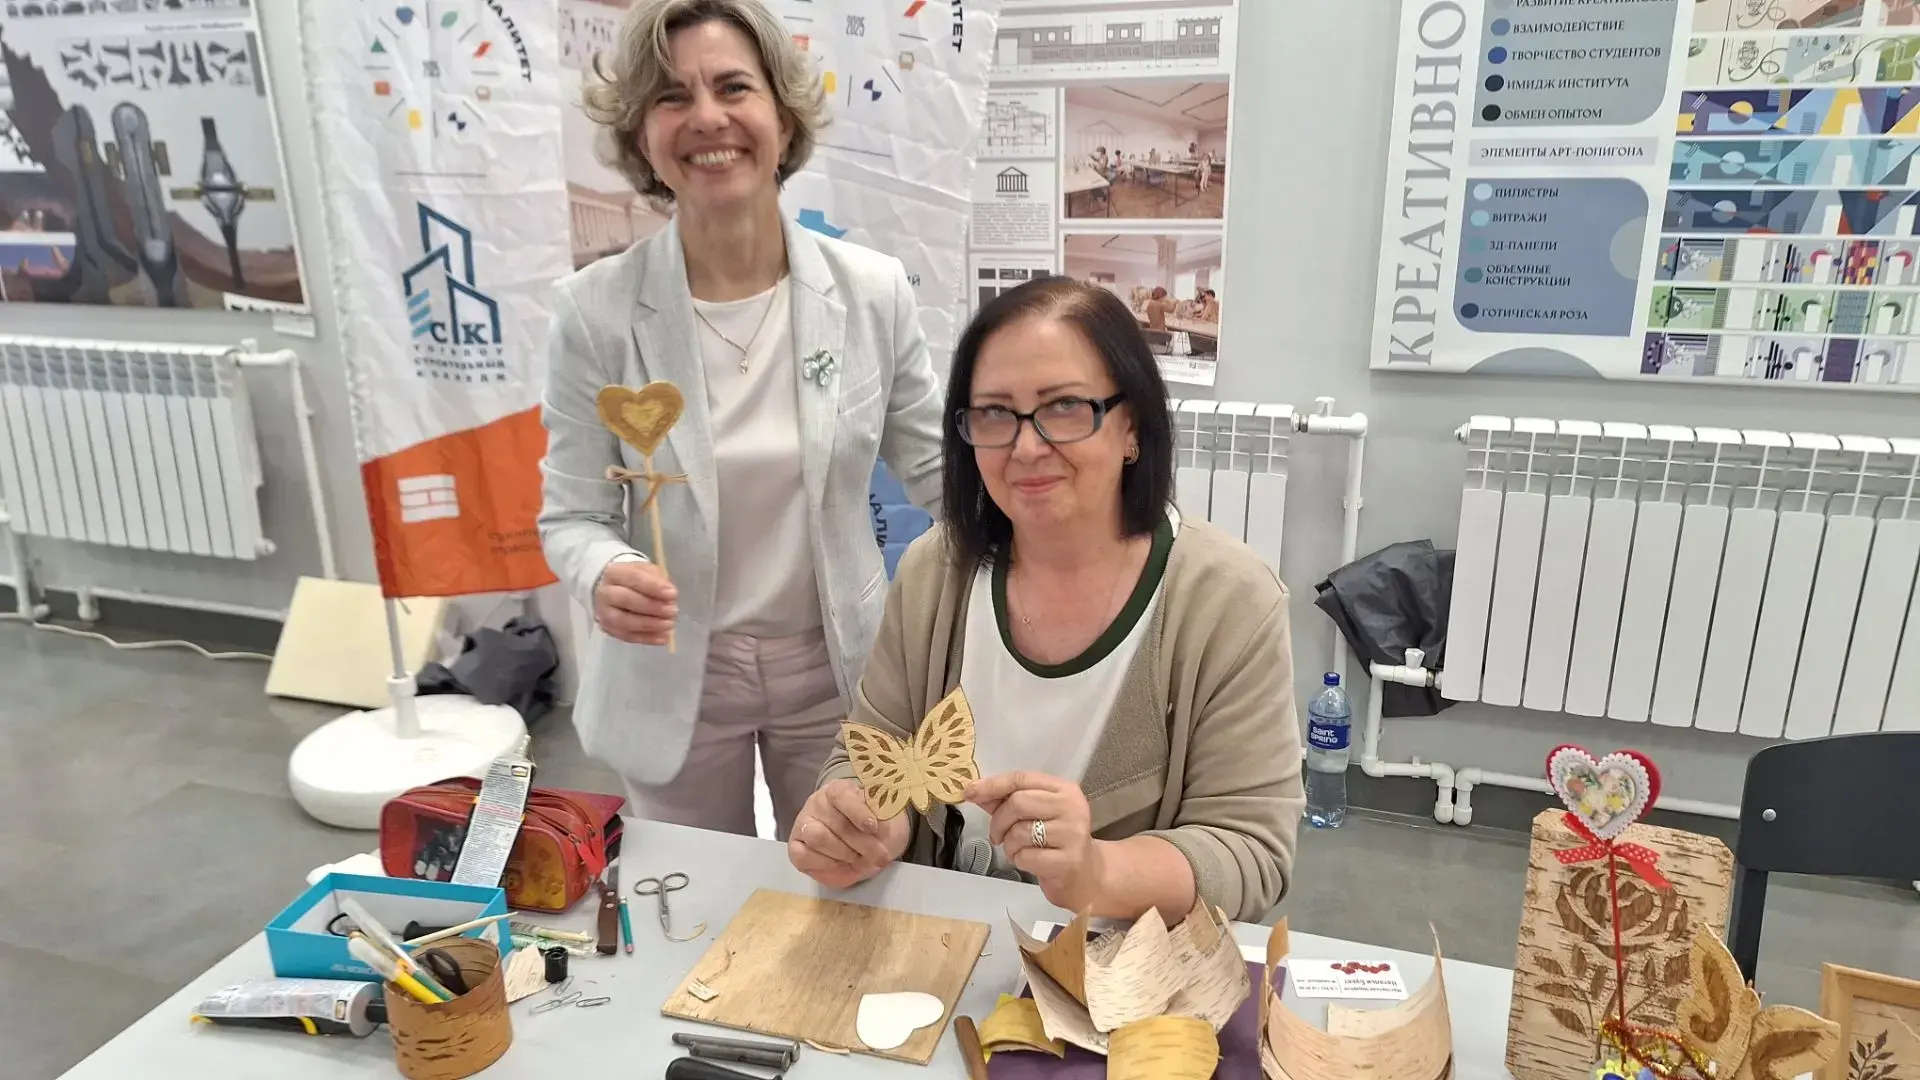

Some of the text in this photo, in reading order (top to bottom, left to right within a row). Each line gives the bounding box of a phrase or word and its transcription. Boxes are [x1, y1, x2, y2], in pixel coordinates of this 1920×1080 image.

[845, 15, 865, 37] 2025
[1513, 20, 1625, 34] ВЗАИМОДЕЙСТВИЕ
[1511, 47, 1661, 61] ТВОРЧЕСТВО СТУДЕНТОВ
[1507, 77, 1629, 90] ИМИДЖ ИНСТИТУТА
[1504, 108, 1603, 120] ОБМЕН ОПЫТОМ
[1388, 0, 1466, 366] КРЕАТИВНО
[1492, 212, 1548, 223] ВИТРАЖИ
[1485, 275, 1571, 287] КОНСТРУКЦИИ
[1481, 307, 1588, 321] ГОТИЧЕСКАЯ РОЗА
